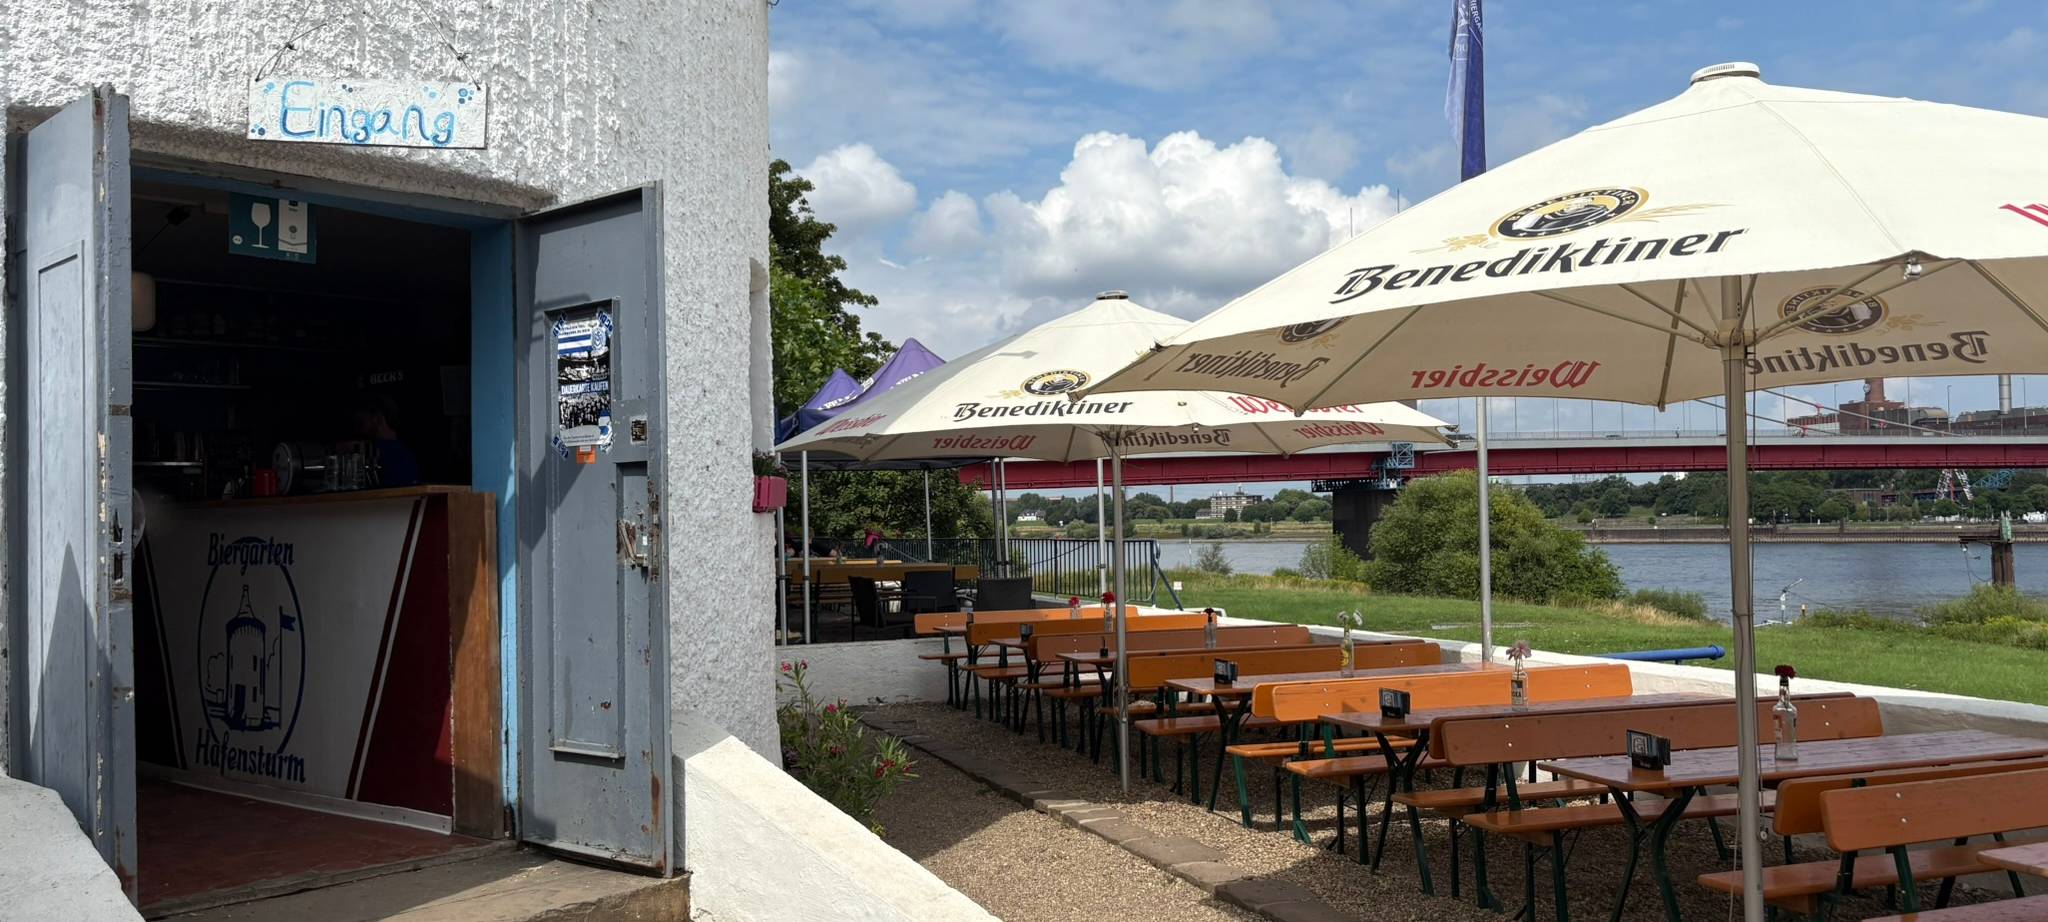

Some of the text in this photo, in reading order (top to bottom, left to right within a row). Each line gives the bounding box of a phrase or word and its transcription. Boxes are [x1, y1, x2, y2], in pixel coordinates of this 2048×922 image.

[280, 80, 455, 146] Eingang
[1329, 227, 1749, 304] Benediktiner
[953, 400, 1133, 422] Benediktiner
[207, 532, 295, 577] Biergarten
[195, 727, 306, 783] Hafensturm
